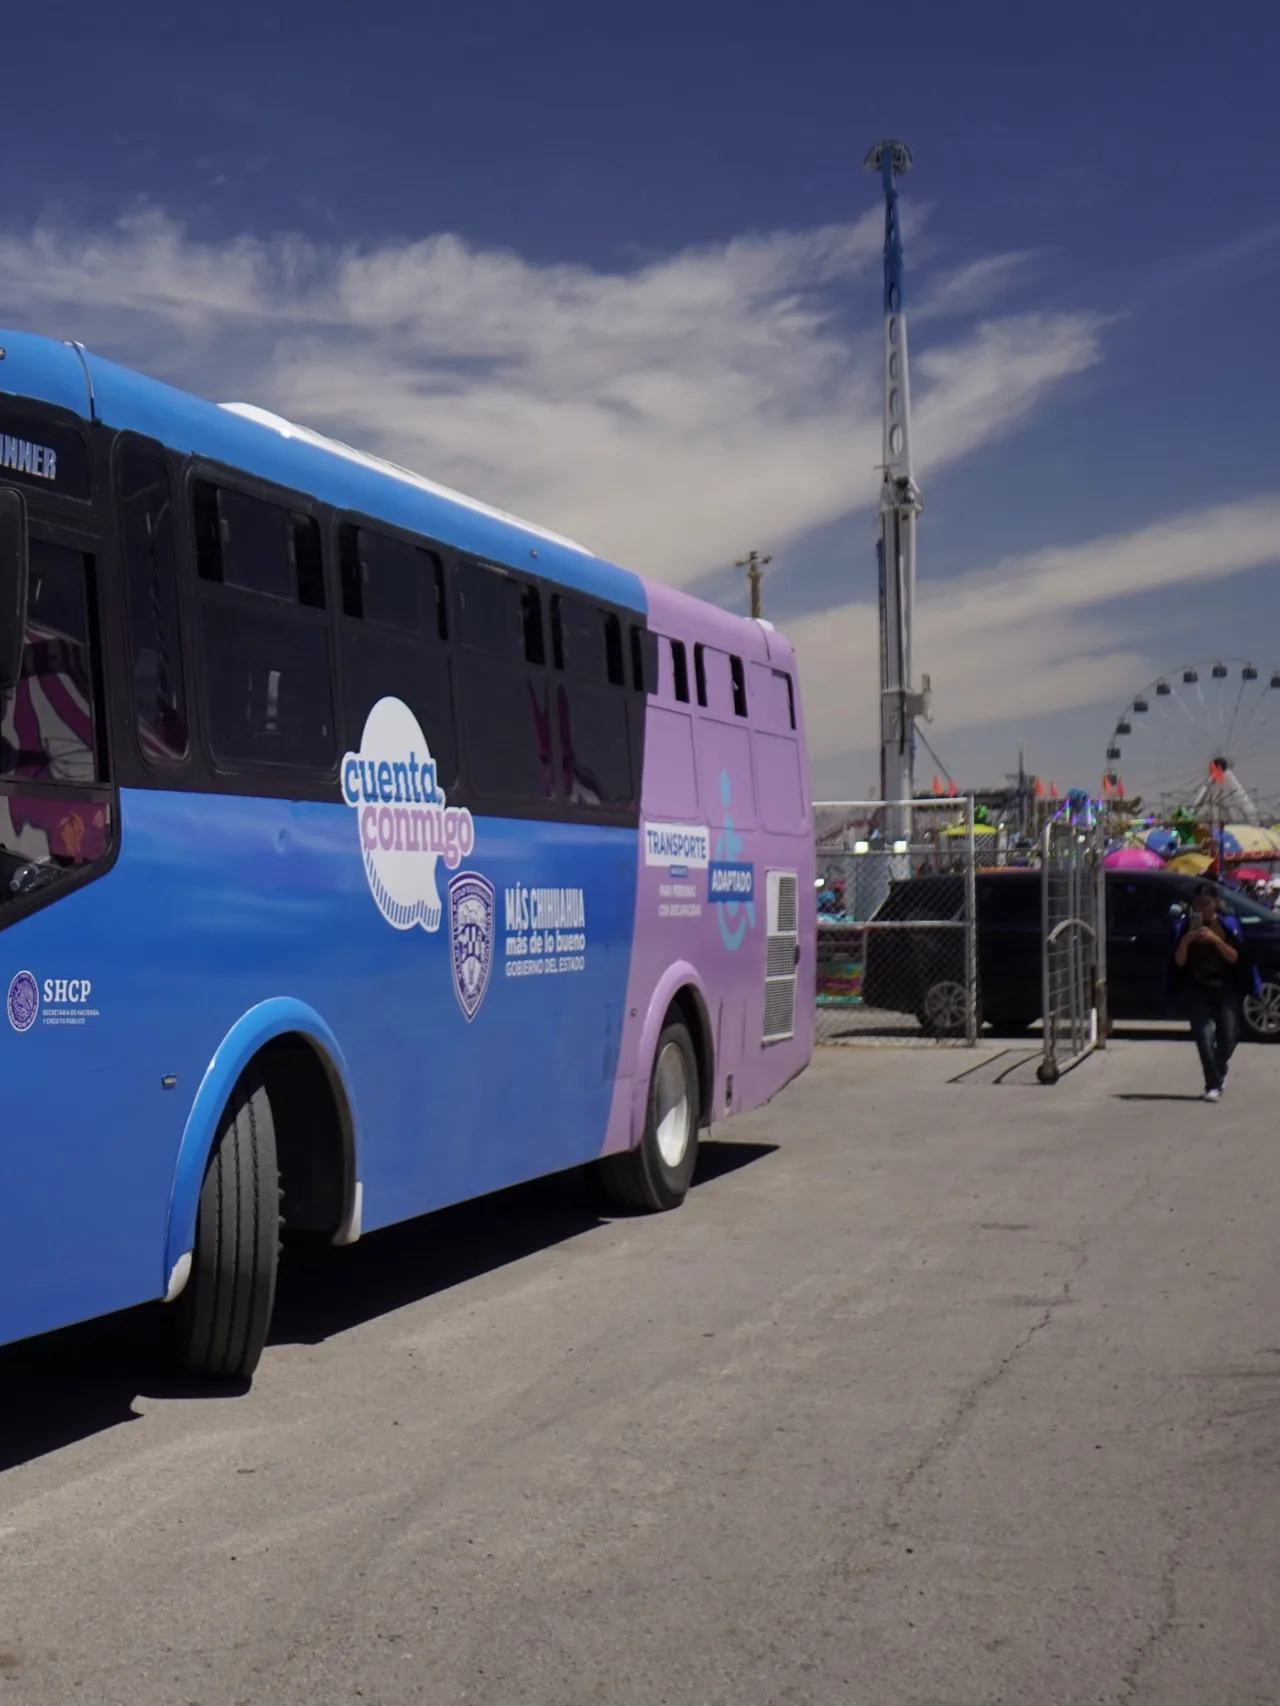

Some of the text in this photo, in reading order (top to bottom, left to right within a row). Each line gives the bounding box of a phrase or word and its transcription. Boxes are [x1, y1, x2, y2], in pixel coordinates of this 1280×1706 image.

[344, 751, 438, 803] cuenta
[361, 806, 472, 867] conmigo
[647, 829, 706, 860] TRANSPORTE
[711, 869, 752, 892] ADAPTADO
[505, 881, 529, 931] MÁS
[530, 888, 585, 930] CHIHUAHUA
[506, 929, 586, 955] más de lo bueno
[505, 955, 585, 977] GOBIERNO DEL ESTADO
[43, 978, 91, 1002] SHCP
